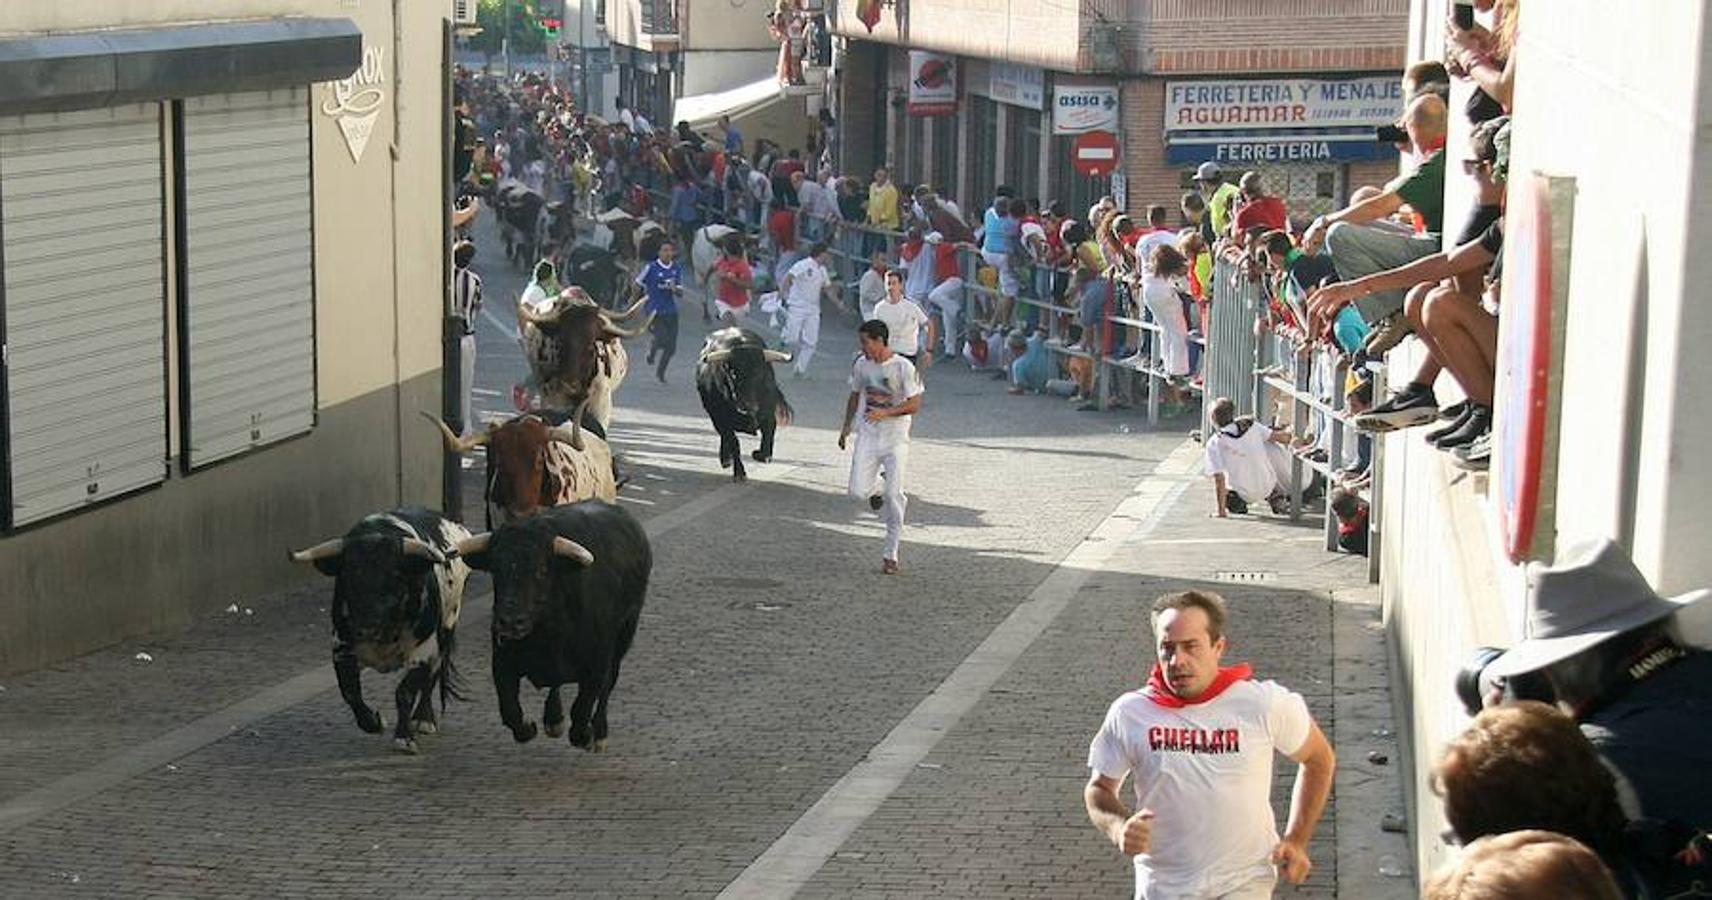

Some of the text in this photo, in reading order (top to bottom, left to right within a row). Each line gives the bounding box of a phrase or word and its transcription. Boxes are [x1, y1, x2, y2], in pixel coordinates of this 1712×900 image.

[1059, 95, 1099, 106] asisa
[1171, 82, 1401, 104] FERRETERIA Y MENAJE
[1177, 104, 1307, 124] AGUAMAR
[1216, 142, 1331, 161] FERRETERIA
[1149, 727, 1239, 752] CUELLAR
